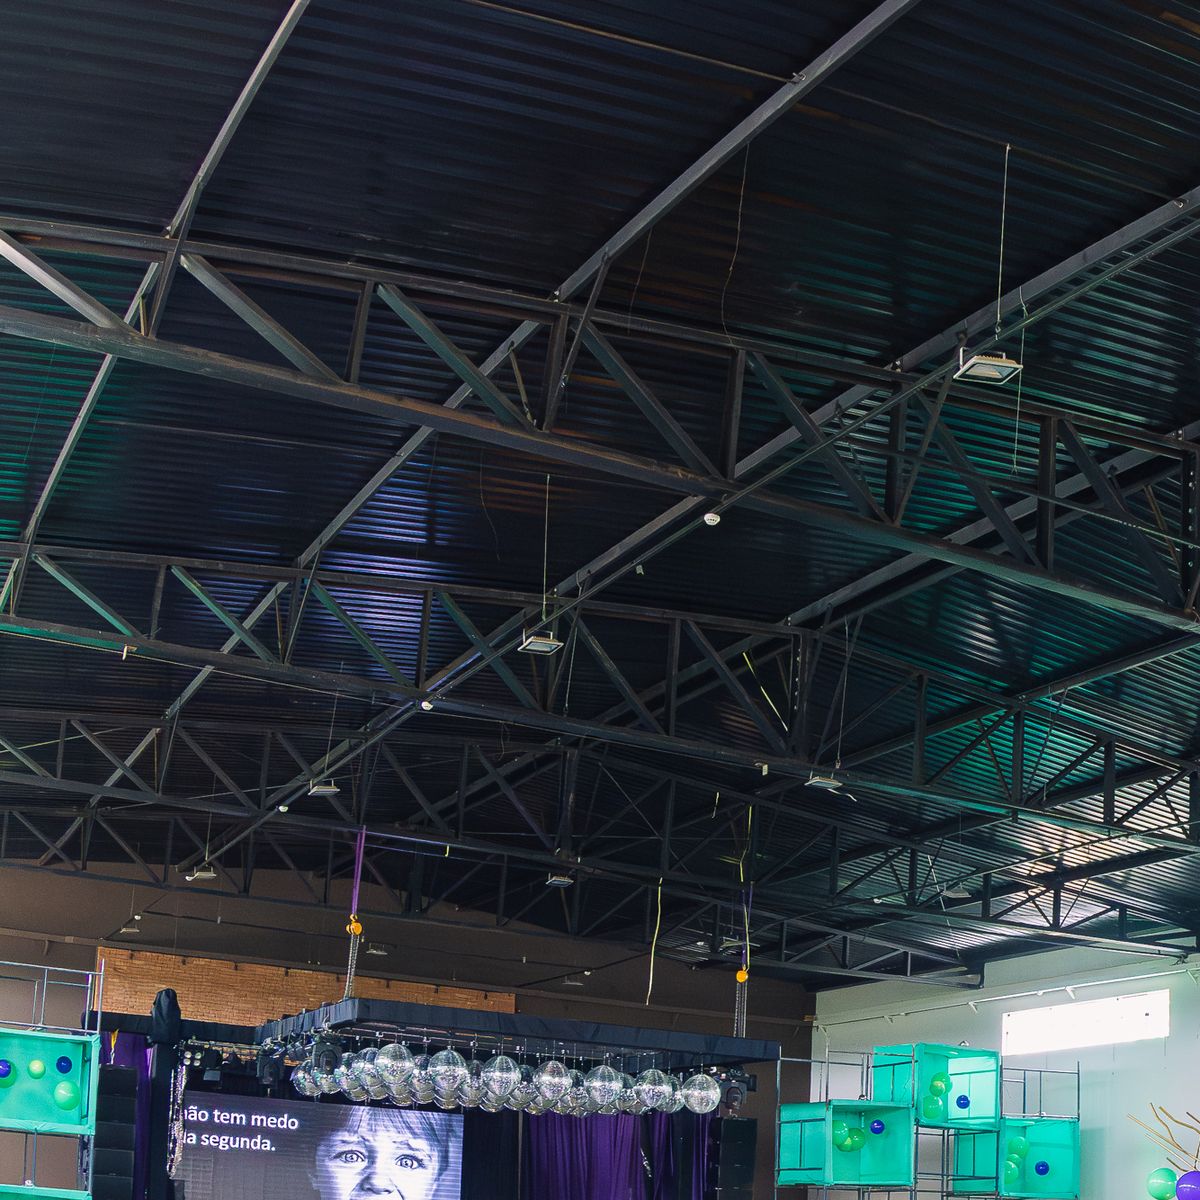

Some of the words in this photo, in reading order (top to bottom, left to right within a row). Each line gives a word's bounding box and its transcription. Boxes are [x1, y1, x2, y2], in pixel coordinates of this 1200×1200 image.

[213, 1109, 246, 1126] tem
[251, 1114, 299, 1130] medo
[200, 1134, 276, 1151] segunda.
